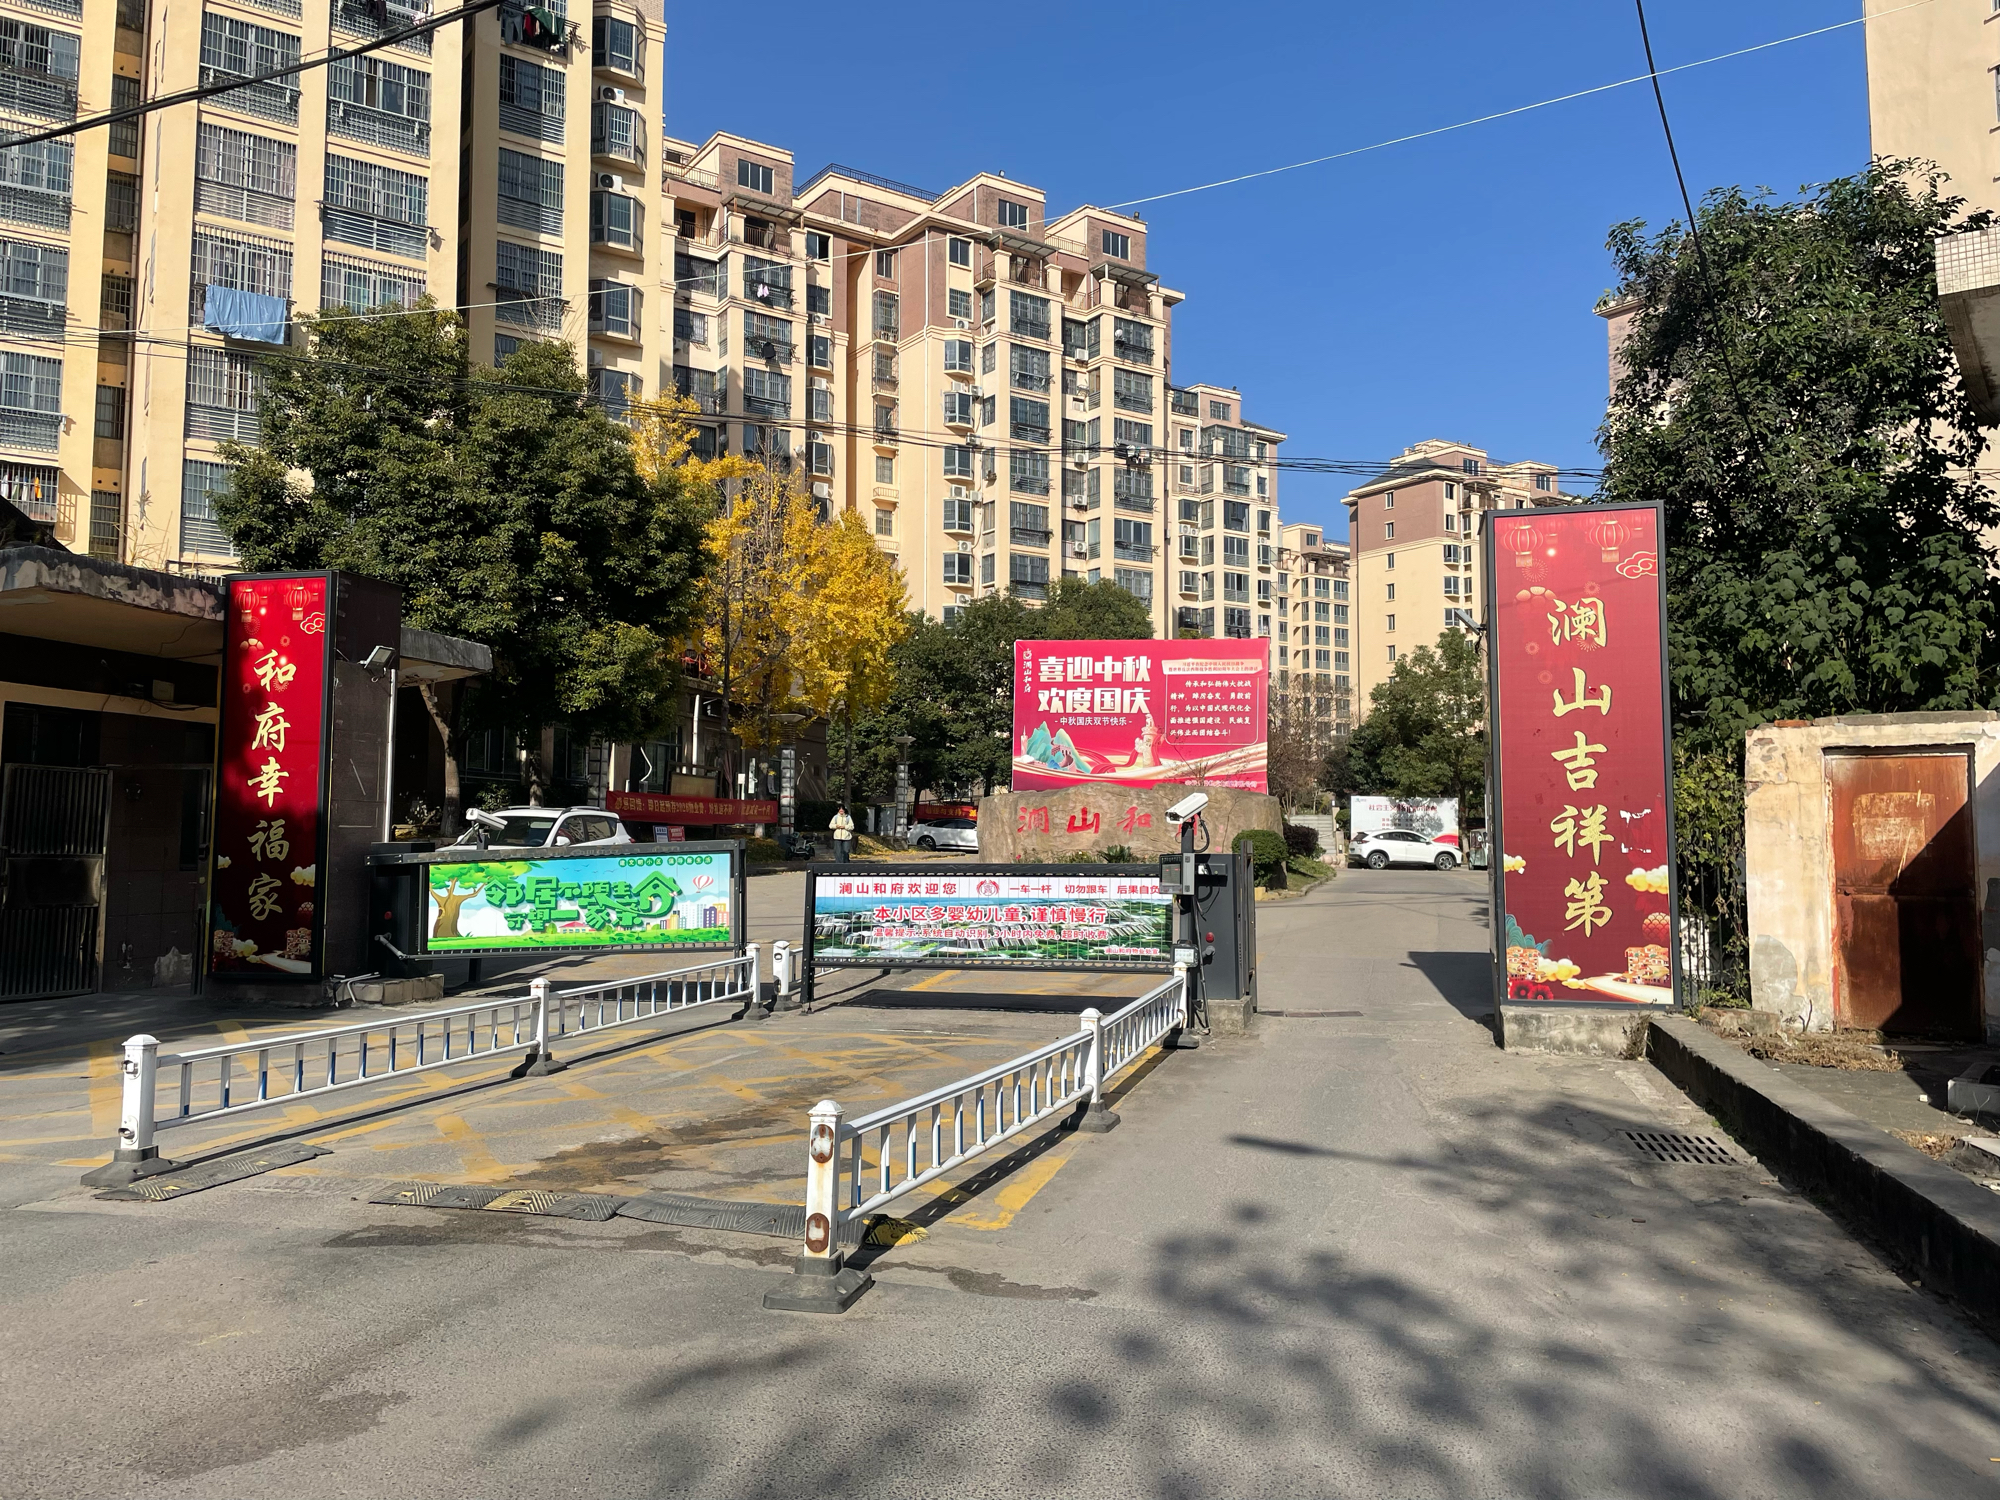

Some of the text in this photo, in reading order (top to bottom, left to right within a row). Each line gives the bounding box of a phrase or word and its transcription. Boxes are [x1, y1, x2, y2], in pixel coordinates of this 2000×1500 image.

[1038, 656, 1151, 682] 喜迎中秋
[1185, 680, 1252, 688] 传承和弘扬伟大抗战
[1037, 687, 1151, 713] 欢度国庆
[1547, 597, 1614, 937] 澜山吉祥第
[247, 648, 297, 921] 和府幸福家
[1017, 806, 1198, 837] 澜山和
[485, 875, 632, 908] 邻居不陌生
[1009, 884, 1052, 894] 一车一杆
[1065, 884, 1108, 894] 切勿跟车
[1117, 884, 1161, 895] 后果自负
